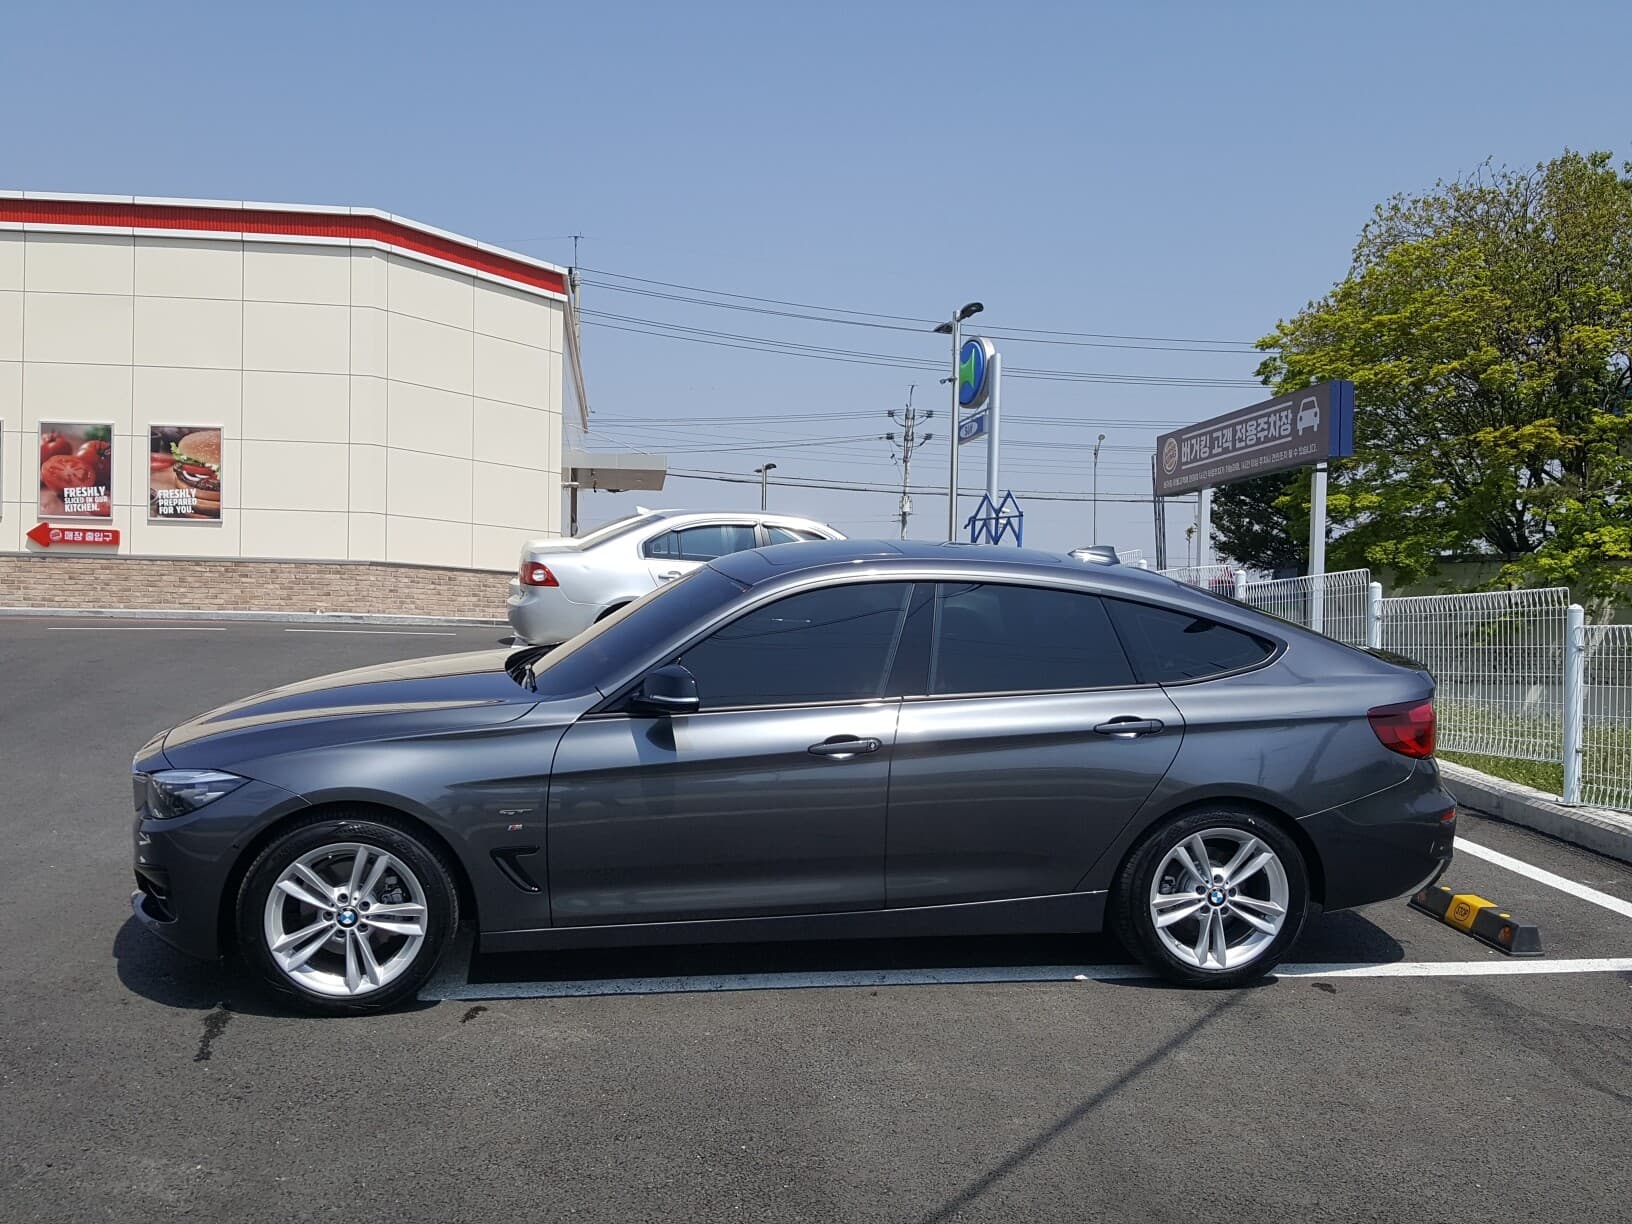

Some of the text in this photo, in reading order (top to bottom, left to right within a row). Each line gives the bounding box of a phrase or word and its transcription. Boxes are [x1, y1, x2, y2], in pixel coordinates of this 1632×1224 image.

[1181, 434, 1210, 462] 버거킹
[1212, 428, 1233, 454] 고객
[1235, 409, 1293, 449] 전용주차장
[63, 485, 106, 497] FRESHLY
[158, 488, 197, 499] FRESHLY
[94, 495, 108, 503] OUR
[158, 497, 198, 506] PREPARED
[64, 503, 100, 512] KITCHEN.
[158, 505, 194, 514] FOR YOU.
[64, 531, 83, 541] 매장
[85, 532, 113, 542] 출입구
